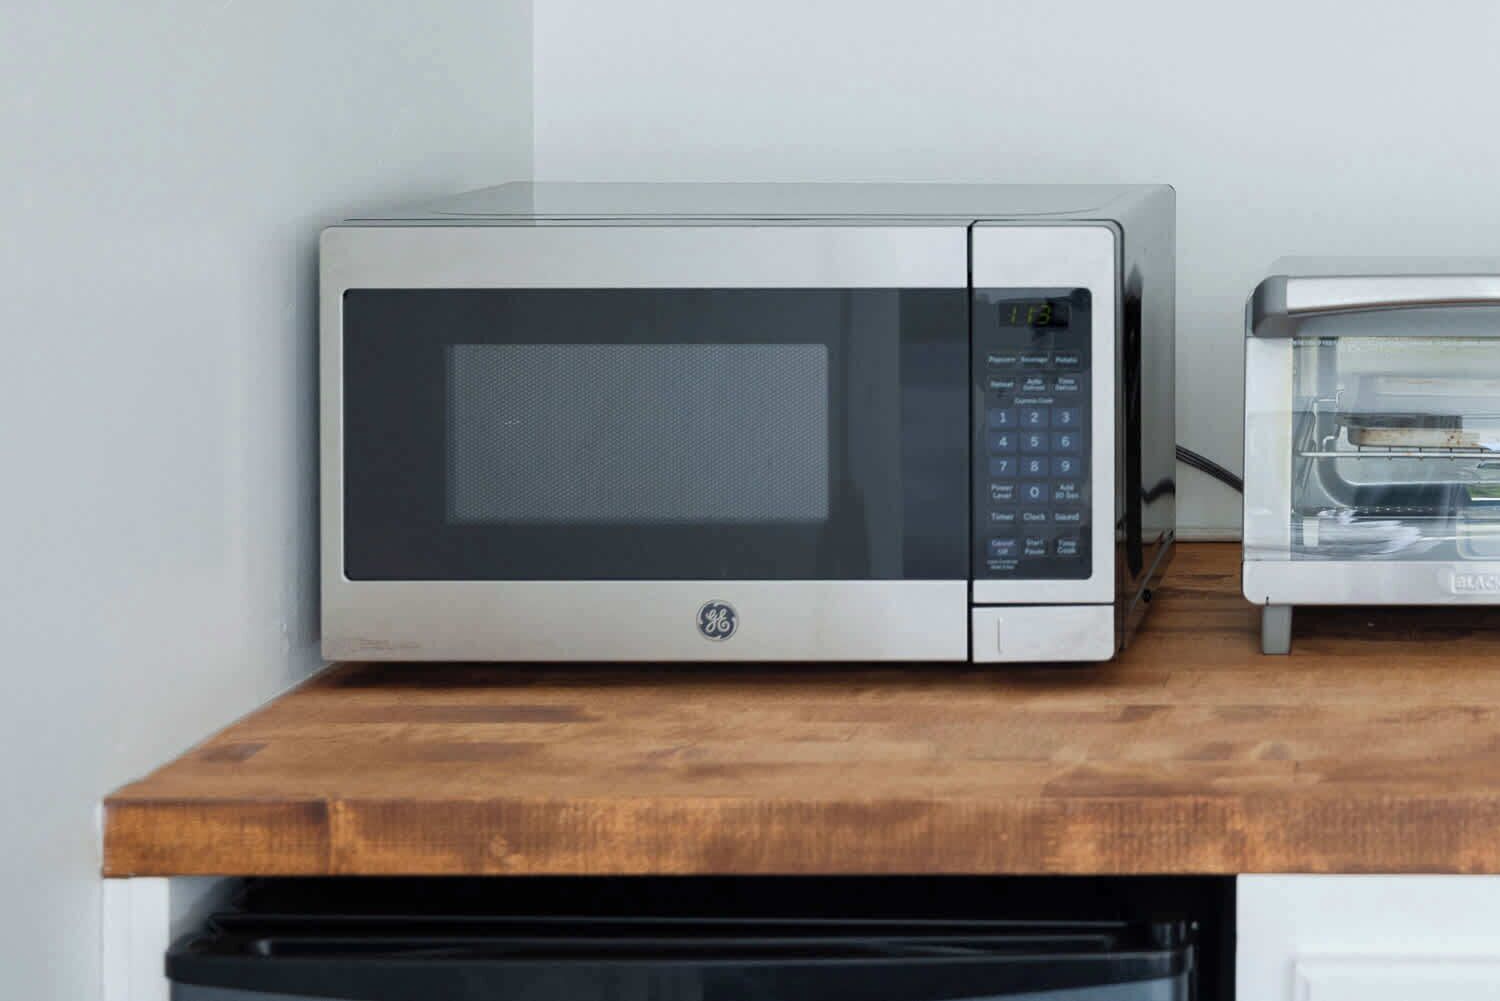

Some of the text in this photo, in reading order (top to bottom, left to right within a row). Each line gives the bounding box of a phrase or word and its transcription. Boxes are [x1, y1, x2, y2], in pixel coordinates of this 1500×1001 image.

[999, 412, 1007, 423] 1
[1030, 412, 1039, 423] 2
[1061, 412, 1070, 423] 3
[999, 436, 1008, 447] 4
[1030, 436, 1039, 447] 5
[1061, 436, 1070, 447] 6
[999, 460, 1007, 472] 7
[1030, 460, 1039, 472] 8
[1061, 460, 1070, 472] 9
[1030, 486, 1040, 498] 0
[1023, 512, 1046, 521] Clock
